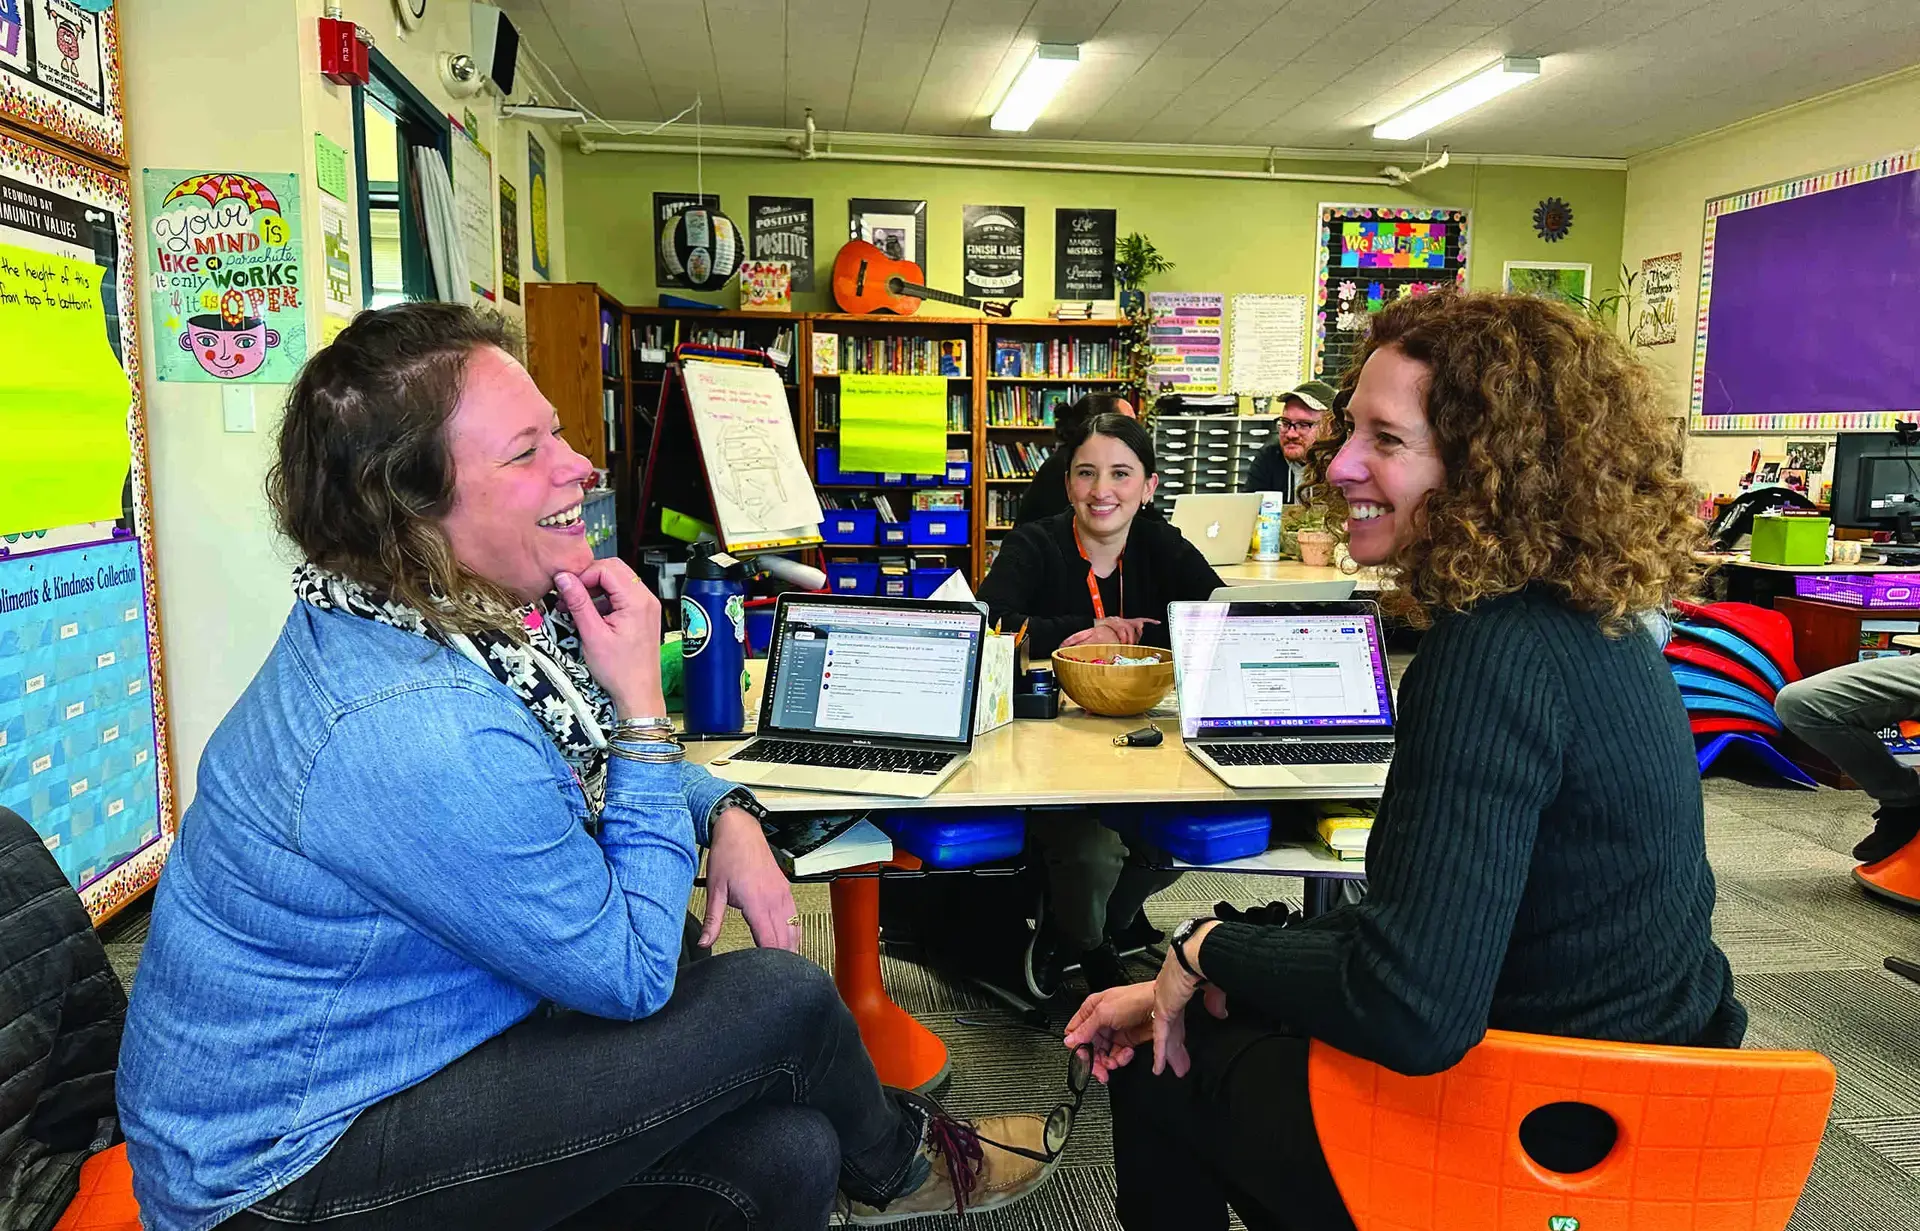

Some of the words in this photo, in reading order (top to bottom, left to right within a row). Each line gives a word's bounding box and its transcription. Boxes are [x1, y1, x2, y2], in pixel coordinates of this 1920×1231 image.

[342, 32, 350, 62] FIRE
[2, 186, 38, 208] REDWOOD
[39, 198, 53, 212] DAY
[43, 214, 77, 239] VALUES
[264, 219, 282, 244] is
[756, 212, 808, 229] POSITIVE
[194, 232, 260, 255] MIND
[756, 232, 809, 260] POSITIVE
[966, 244, 998, 255] FINISH
[1000, 245, 1022, 256] LINE
[1066, 247, 1104, 256] MISTAKES
[1068, 239, 1101, 247] MAKING
[1344, 235, 1368, 252] We
[1, 256, 20, 277] the
[61, 265, 69, 286] of
[158, 247, 200, 273] like
[206, 256, 222, 271] a
[156, 274, 167, 288] It
[172, 273, 210, 294] only
[210, 262, 298, 288] WORKS
[970, 276, 1017, 287] COURAGE
[1646, 280, 1673, 296] kindness
[0, 281, 20, 305] from
[24, 288, 41, 310] top
[46, 292, 56, 306] to
[170, 292, 182, 315] if
[186, 295, 200, 314] it
[204, 294, 219, 308] IS
[0, 585, 39, 614] liments
[42, 579, 52, 603] &
[53, 572, 95, 599] Kindness
[97, 564, 136, 590] Collection
[1552, 1217, 1578, 1231] VS
